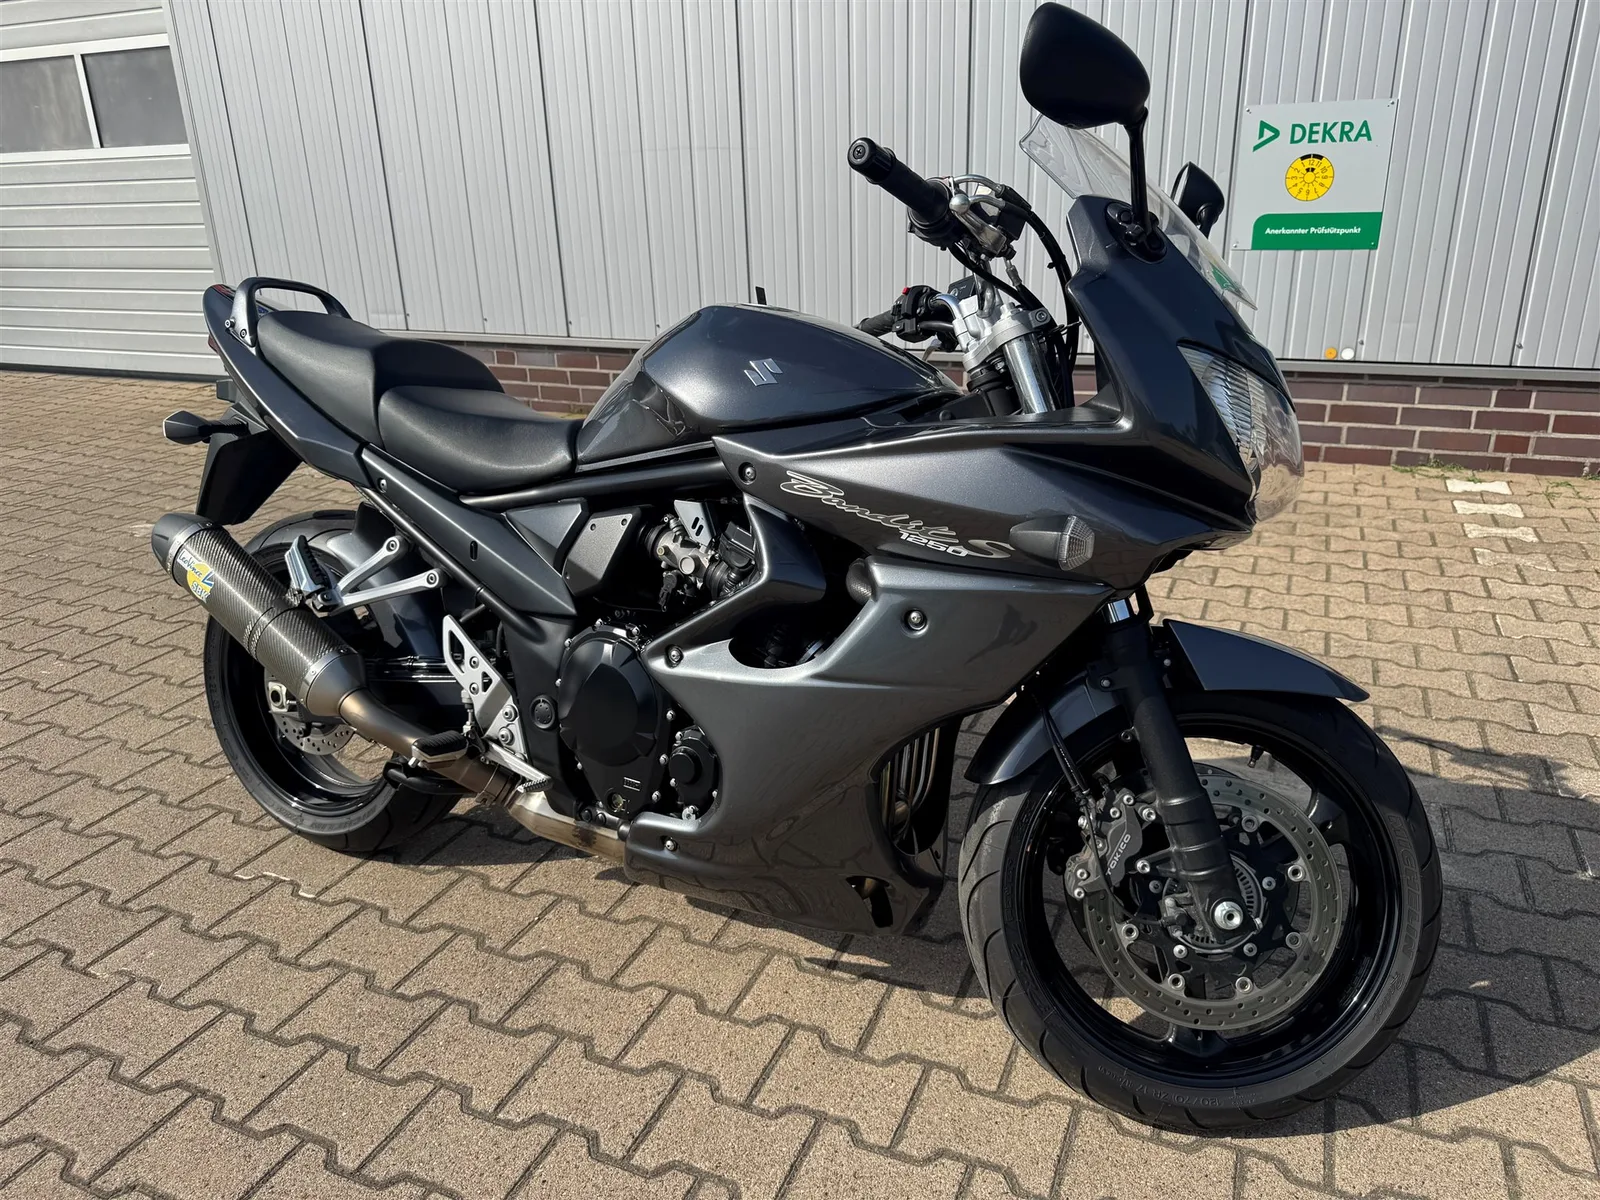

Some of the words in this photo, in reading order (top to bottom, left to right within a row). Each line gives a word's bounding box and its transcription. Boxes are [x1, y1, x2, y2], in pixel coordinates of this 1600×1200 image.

[1290, 120, 1372, 144] DEKRA
[1265, 227, 1309, 235] Anerkannter
[1310, 226, 1361, 236] Prüfstützpunkt
[780, 470, 959, 544] Bandit
[899, 531, 968, 557] 1250
[957, 539, 1016, 558] S
[178, 550, 203, 578] LeoVince
[1106, 833, 1131, 876] TOKICO
[1387, 814, 1421, 960] MICHELIN
